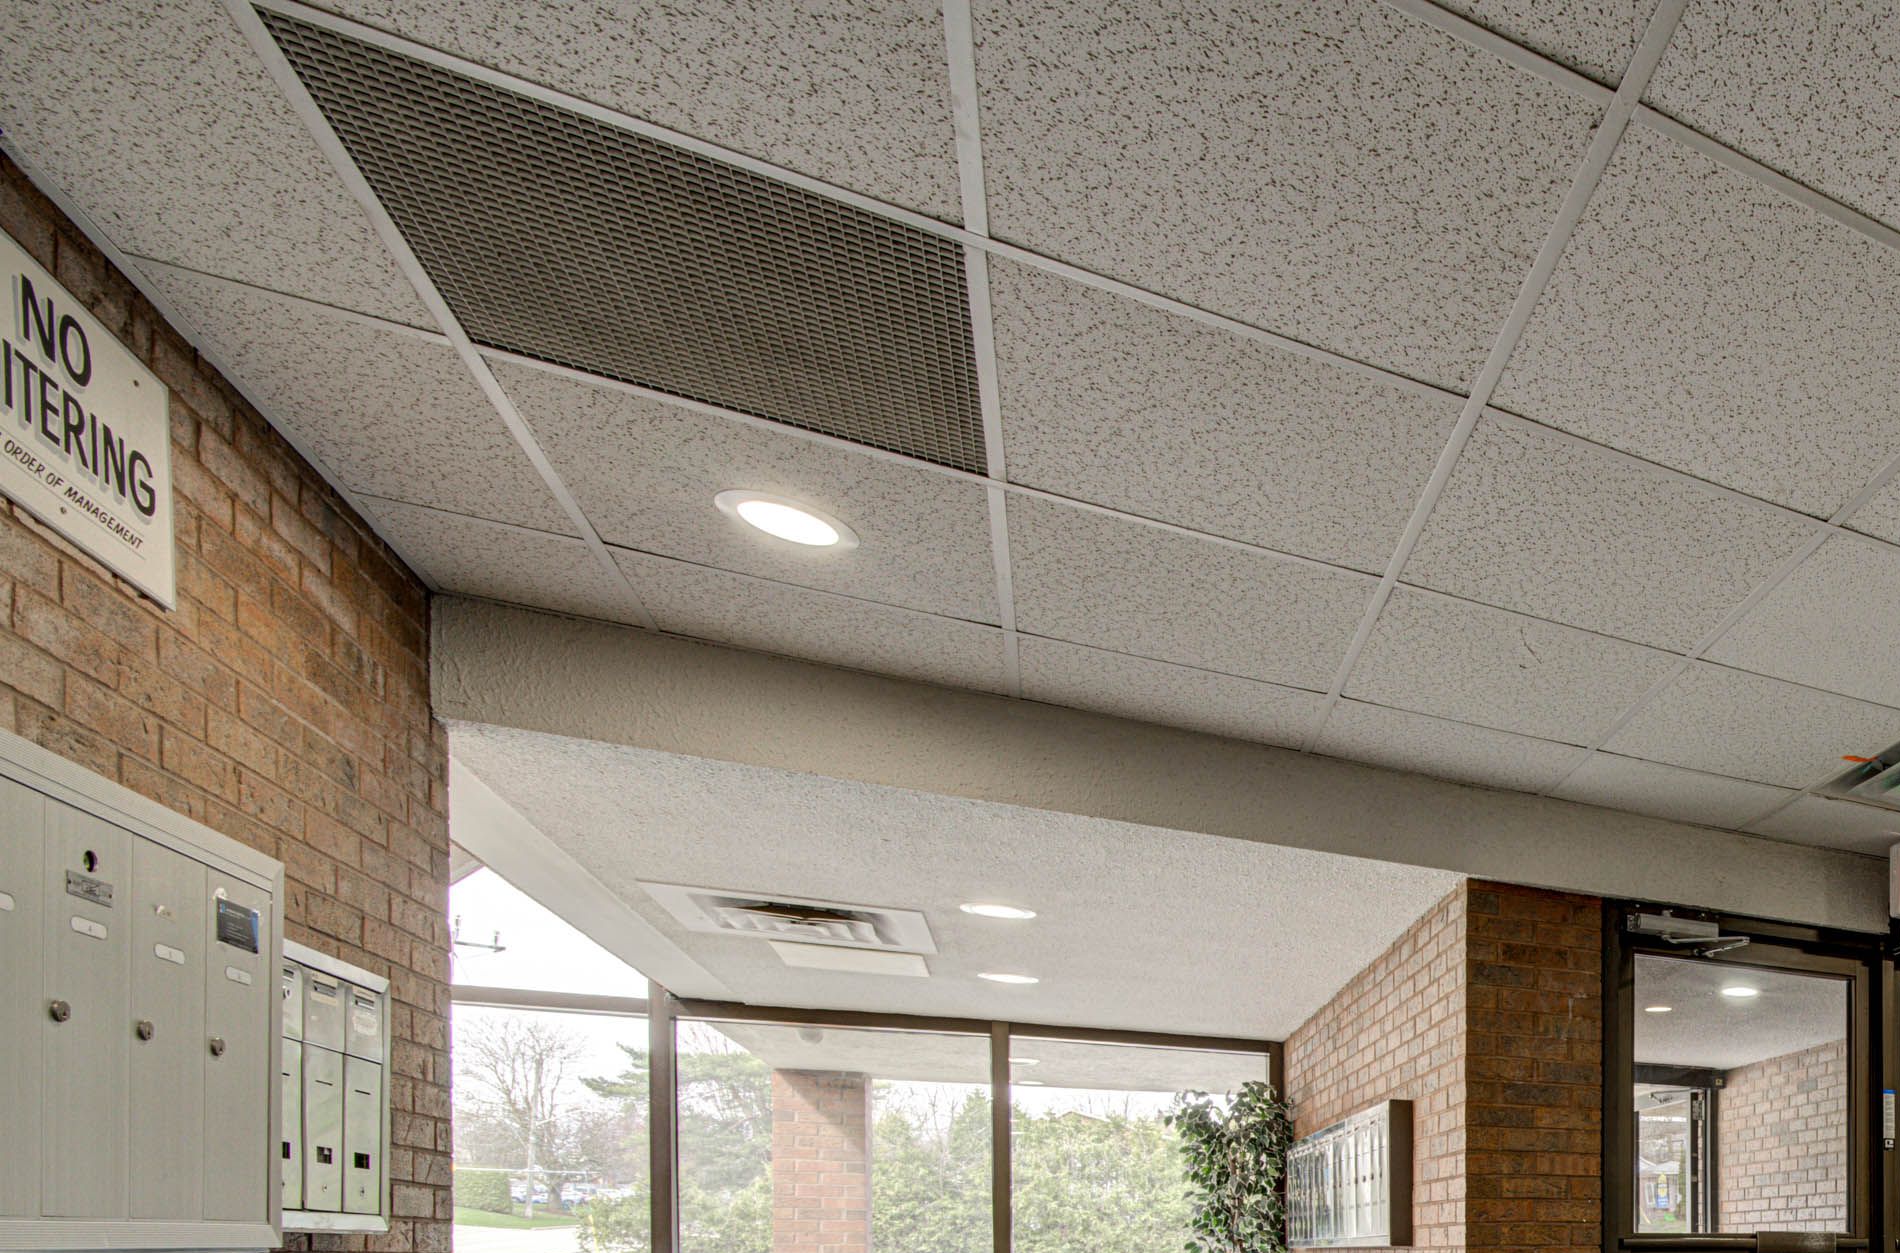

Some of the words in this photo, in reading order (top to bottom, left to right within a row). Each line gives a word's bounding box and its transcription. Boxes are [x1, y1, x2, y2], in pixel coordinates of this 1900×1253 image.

[20, 272, 92, 388] NO
[1, 338, 157, 518] ITERING
[4, 440, 46, 479] ORDER
[46, 472, 65, 488] OF
[64, 486, 144, 549] MANAGEMENT
